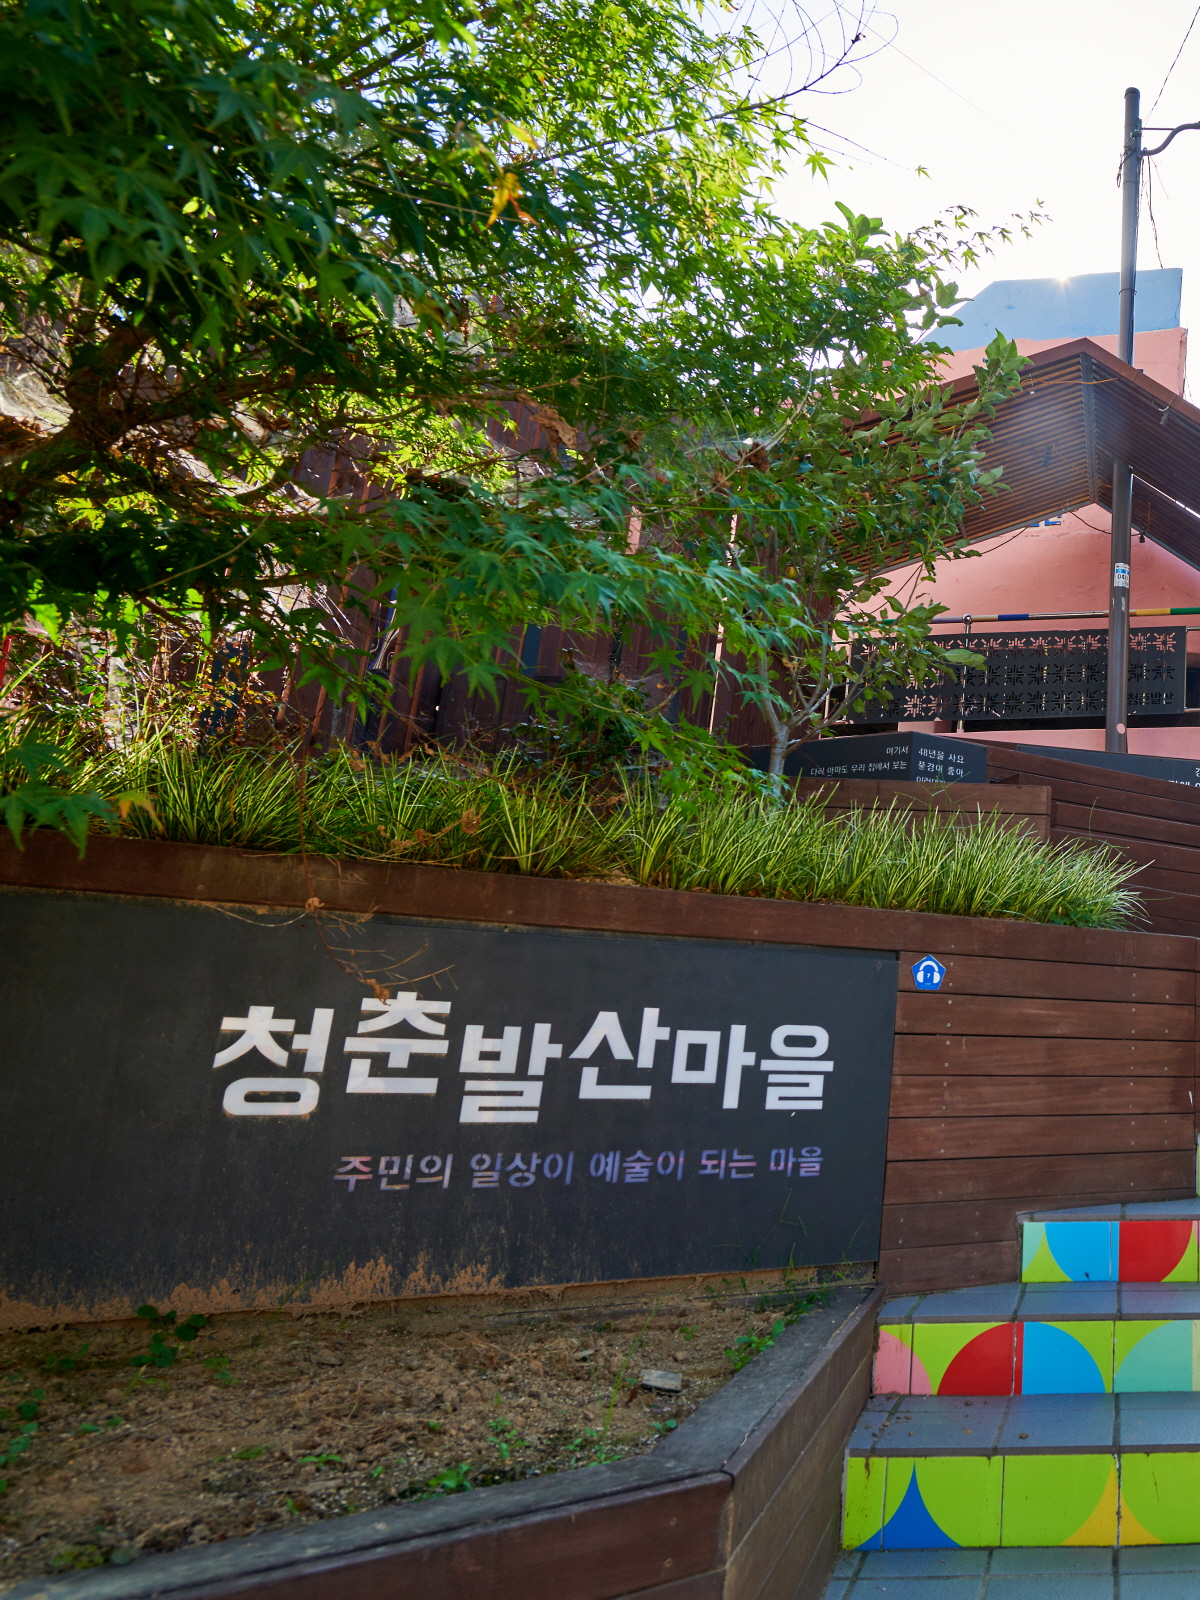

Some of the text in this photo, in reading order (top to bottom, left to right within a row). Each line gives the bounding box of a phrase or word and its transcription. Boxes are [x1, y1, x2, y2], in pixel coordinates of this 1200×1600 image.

[1127, 691, 1174, 706] 청춘발산
[886, 745, 909, 756] 여기서
[918, 747, 945, 761] 48년을
[810, 760, 908, 777] 다리 아파도 우리 집에서 보는
[917, 760, 964, 778] 풍경이 좋아
[212, 991, 834, 1124] 청춘발산마을
[332, 1145, 824, 1192] 주민의 일상이 예술이 되는 마을
